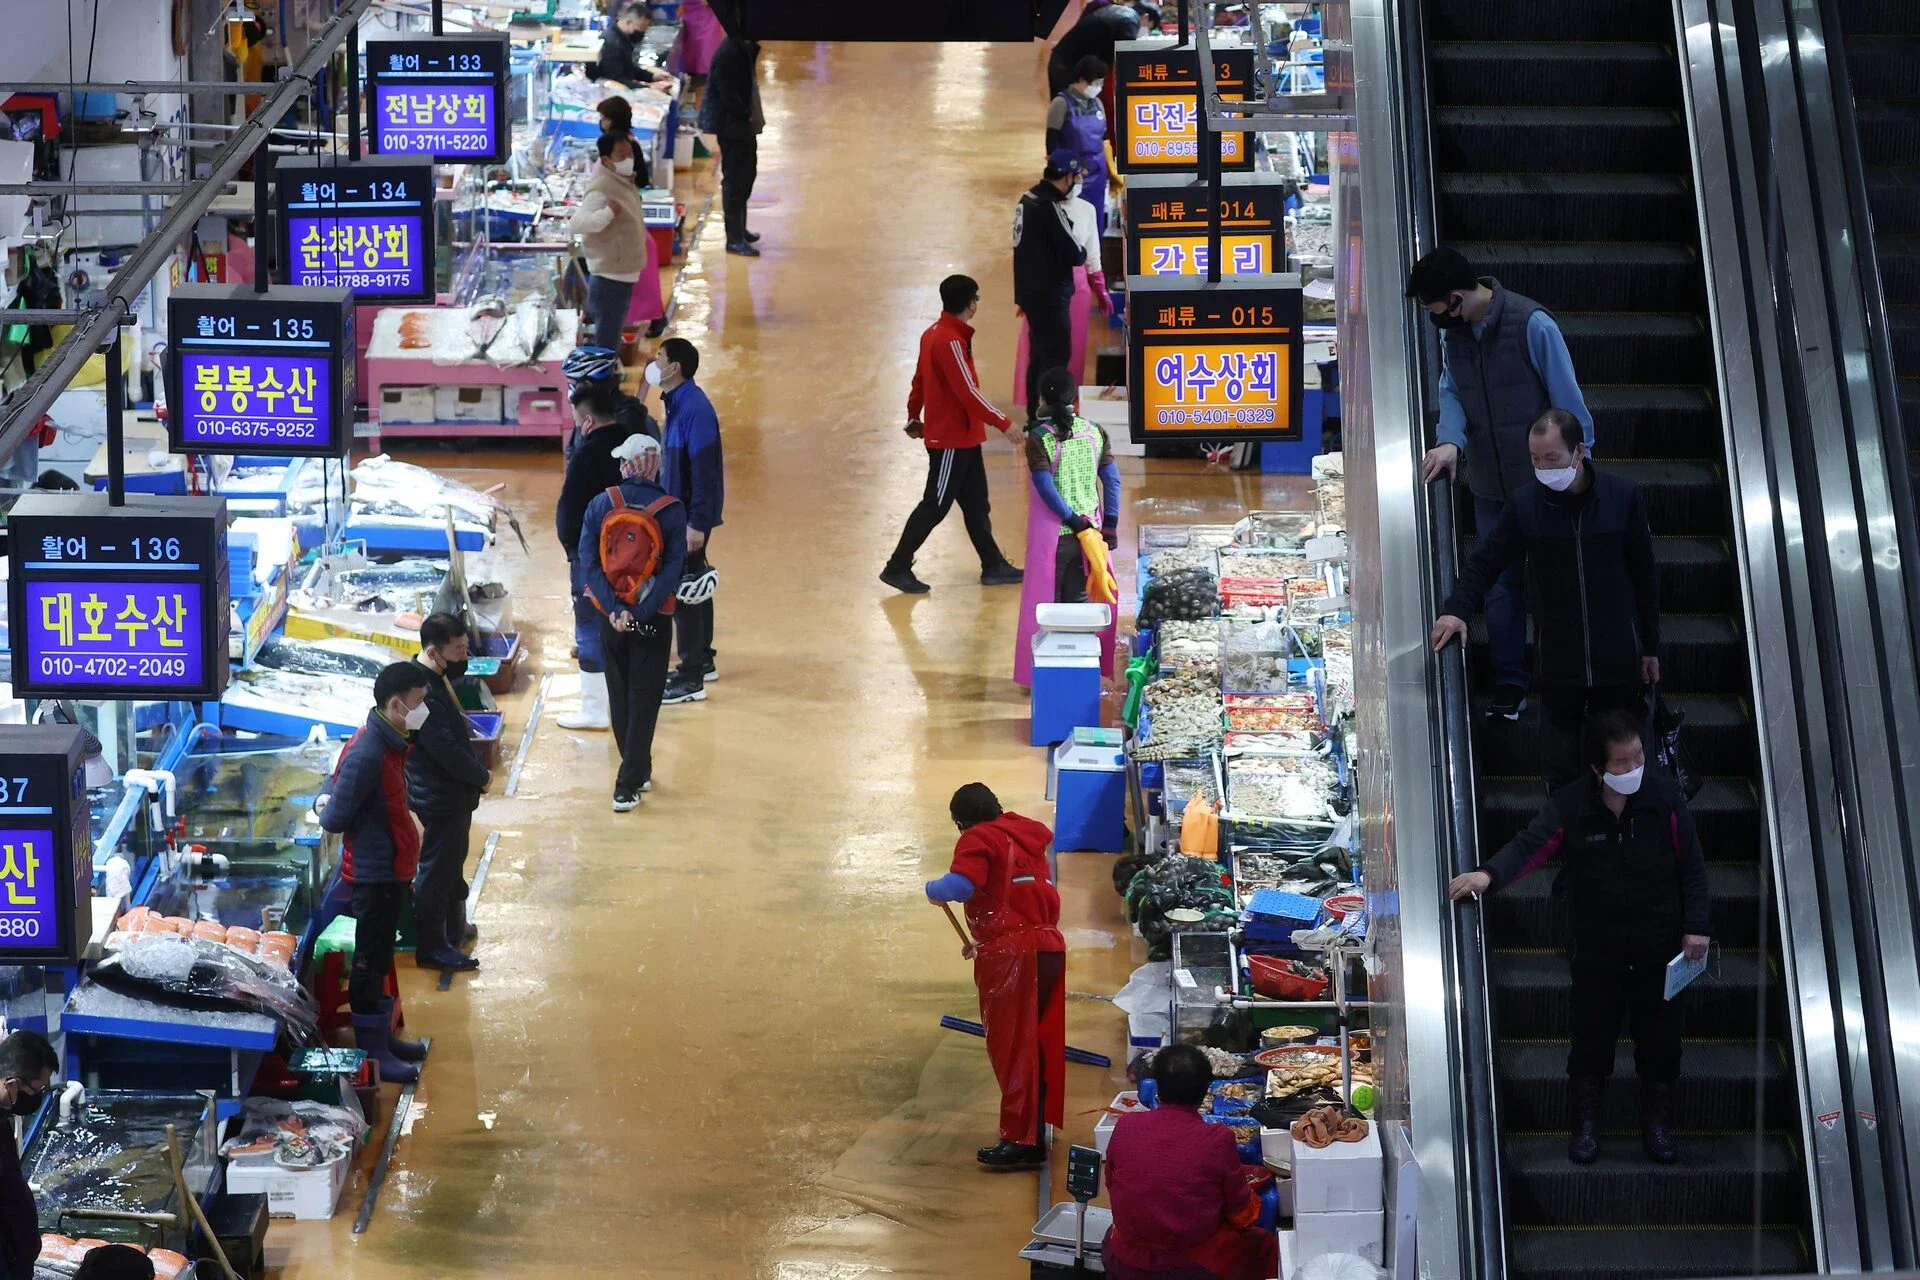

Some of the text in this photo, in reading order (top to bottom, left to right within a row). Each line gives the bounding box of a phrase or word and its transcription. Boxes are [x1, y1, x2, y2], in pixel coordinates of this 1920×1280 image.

[389, 54, 420, 71] 활어
[448, 54, 482, 71] 133
[1138, 64, 1169, 81] 패류
[385, 93, 486, 125] 전남상회
[384, 134, 488, 151] 010-3711-5220
[301, 182, 336, 202] 활어
[368, 181, 407, 200] 134
[1151, 201, 1186, 221] 패류
[1220, 200, 1256, 219] 014
[300, 224, 409, 268] 순천상회
[302, 273, 410, 288] 010-8788-9175
[196, 315, 236, 338] 활어
[272, 318, 314, 339] 135
[1158, 306, 1196, 327] 패류
[1231, 306, 1274, 326] 015
[1155, 352, 1279, 402] 여수상회
[194, 364, 317, 414] 봉봉수산
[1158, 408, 1276, 425] 010-5401-0329
[197, 420, 315, 438] 010-6375-9252
[41, 535, 87, 561] 활어
[131, 537, 180, 560] 136
[40, 592, 187, 649] 대호수산
[41, 657, 185, 678] 010-4702-2049
